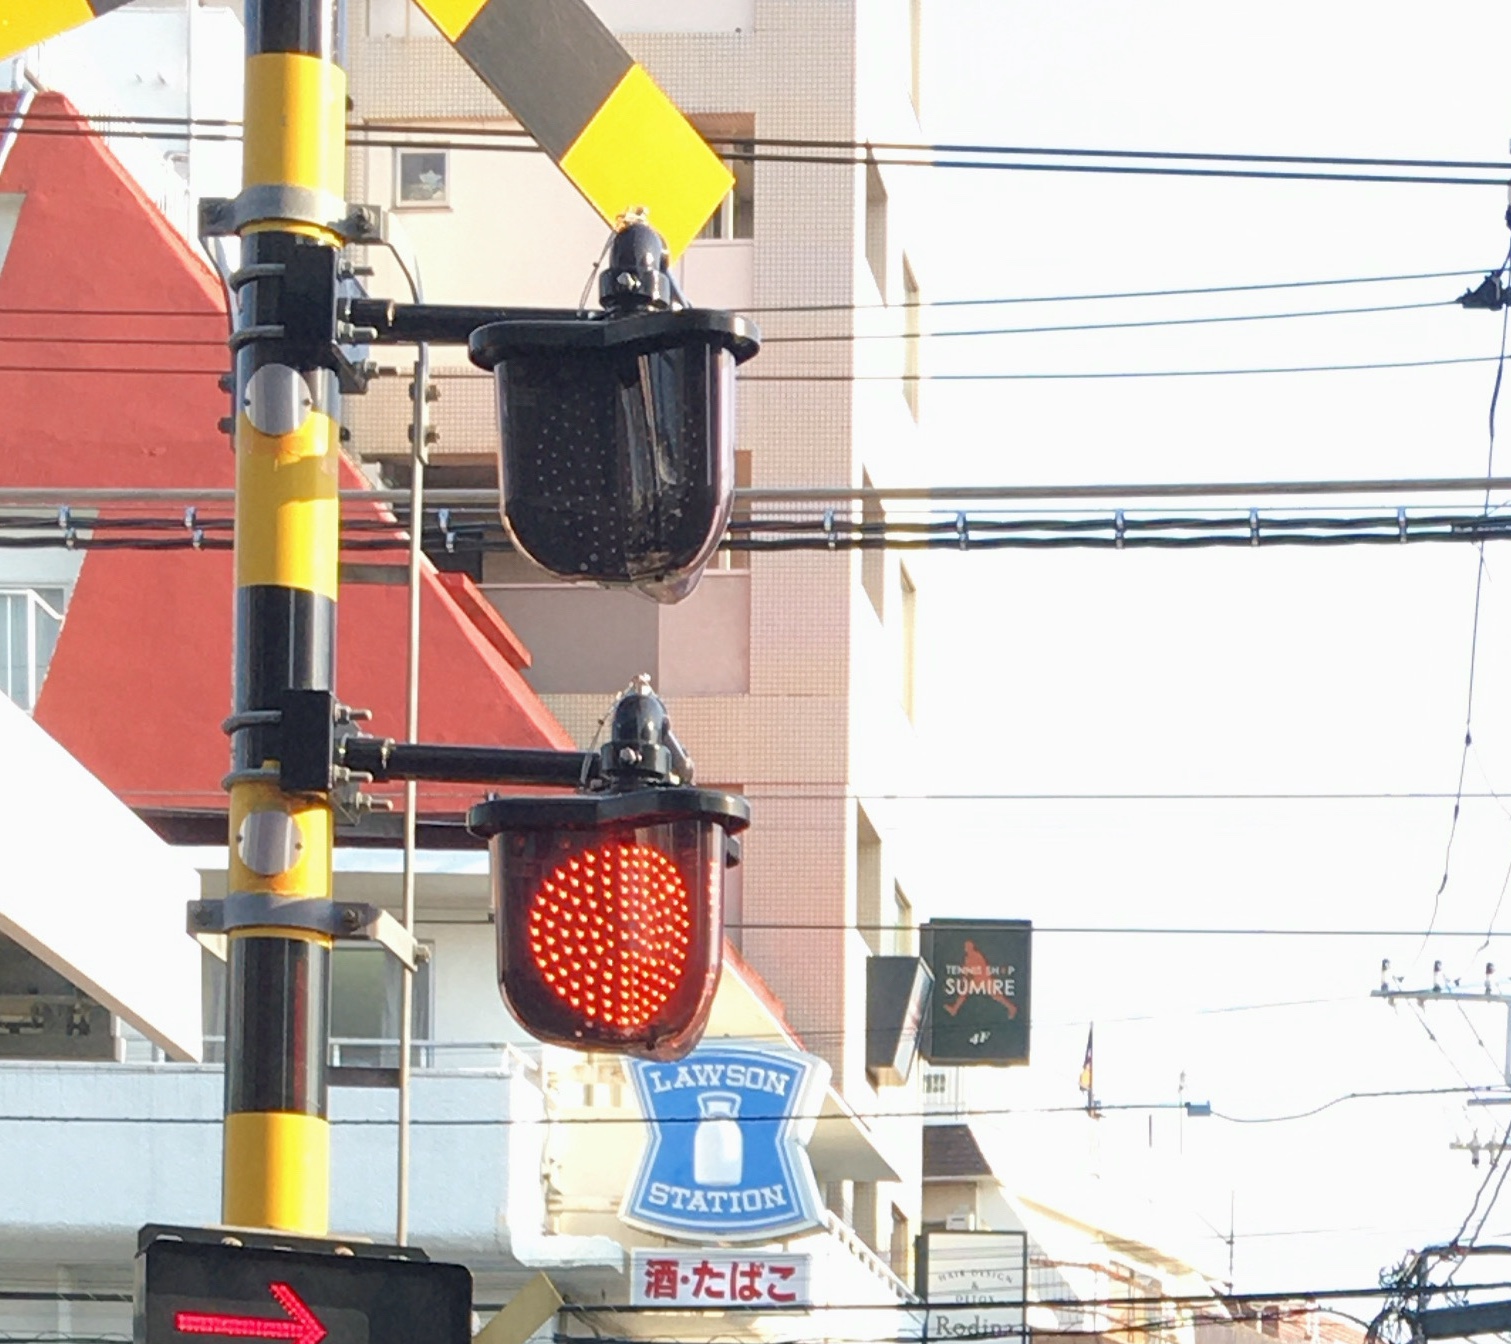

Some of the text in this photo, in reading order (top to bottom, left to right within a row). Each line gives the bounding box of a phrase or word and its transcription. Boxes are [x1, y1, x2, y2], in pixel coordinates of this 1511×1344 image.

[945, 978, 1015, 996] SUMIRE
[650, 1065, 791, 1096] LAWSON
[649, 1183, 787, 1214] STATION
[645, 1259, 796, 1302] 酒・たばこ
